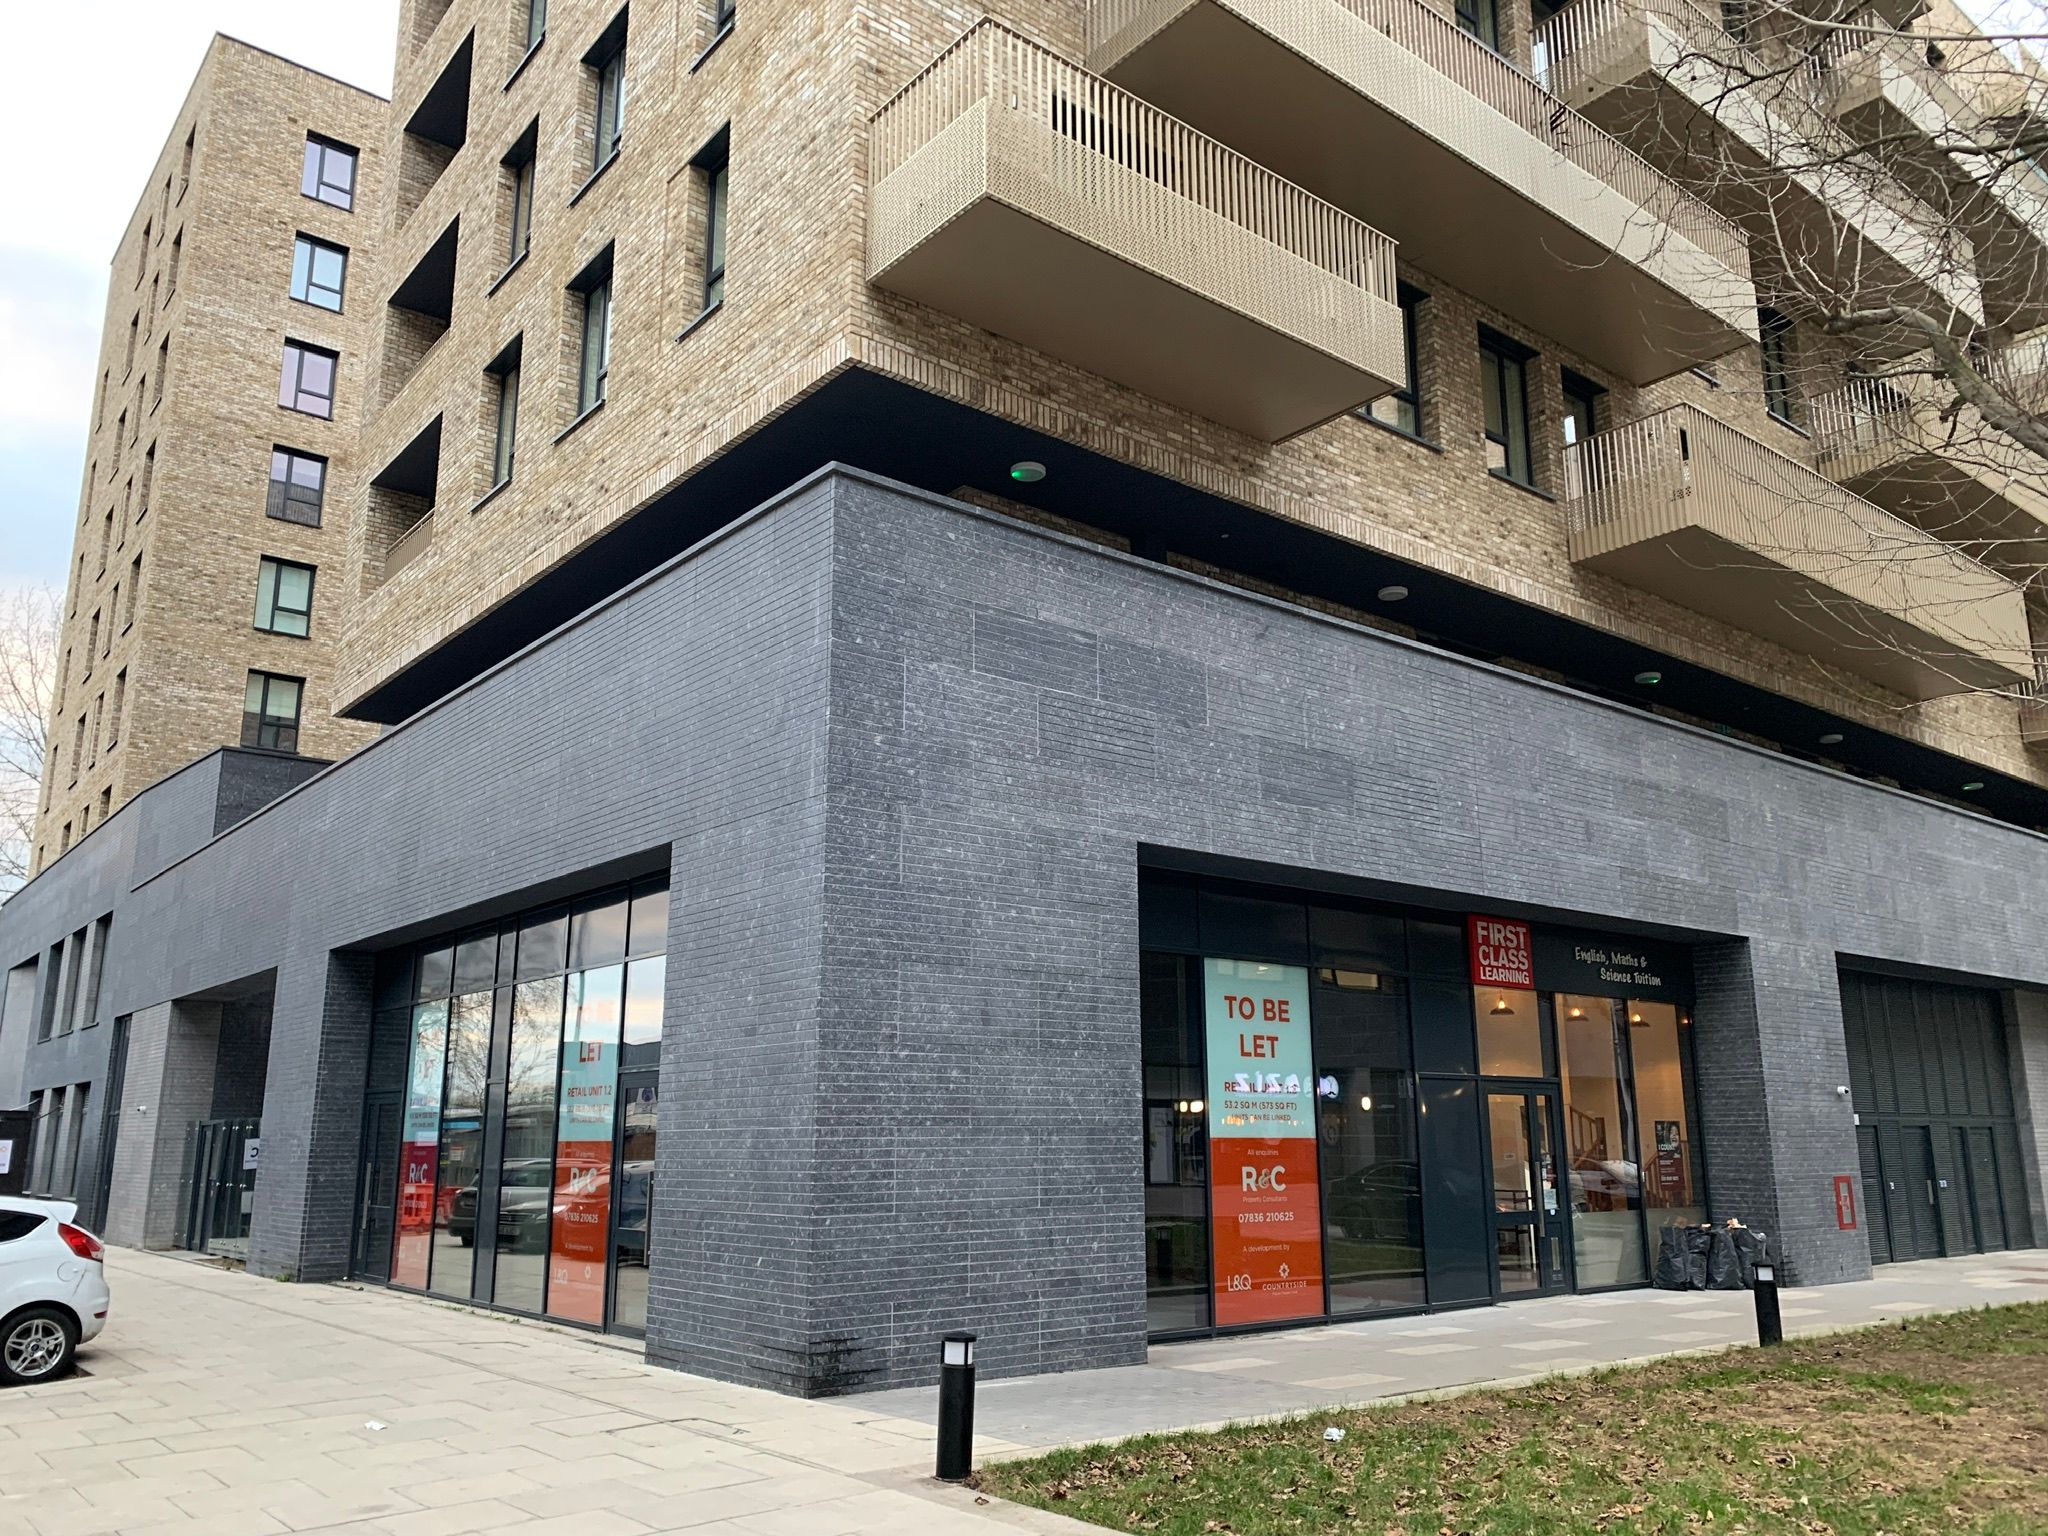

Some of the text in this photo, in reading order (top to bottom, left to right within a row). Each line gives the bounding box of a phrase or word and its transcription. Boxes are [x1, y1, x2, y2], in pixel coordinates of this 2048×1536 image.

[1477, 921, 1526, 949] FIRST
[1479, 945, 1529, 970] CLASS
[1575, 947, 1648, 968] English, Maths &
[1480, 966, 1530, 985] LEARNING
[1600, 967, 1662, 986] Science Tuition
[1224, 995, 1290, 1022] TO BE
[1240, 1034, 1279, 1058] LET
[567, 1087, 586, 1098] RETAIL
[588, 1086, 603, 1097] UNIT
[1224, 1101, 1298, 1111] 53.2 SQ M (573 SQ FT)
[1241, 1165, 1287, 1192] R&C
[1238, 1211, 1295, 1223] 07836 210625
[1227, 1273, 1252, 1292] L&Q
[1262, 1280, 1308, 1291] COUNTRYSIDE
